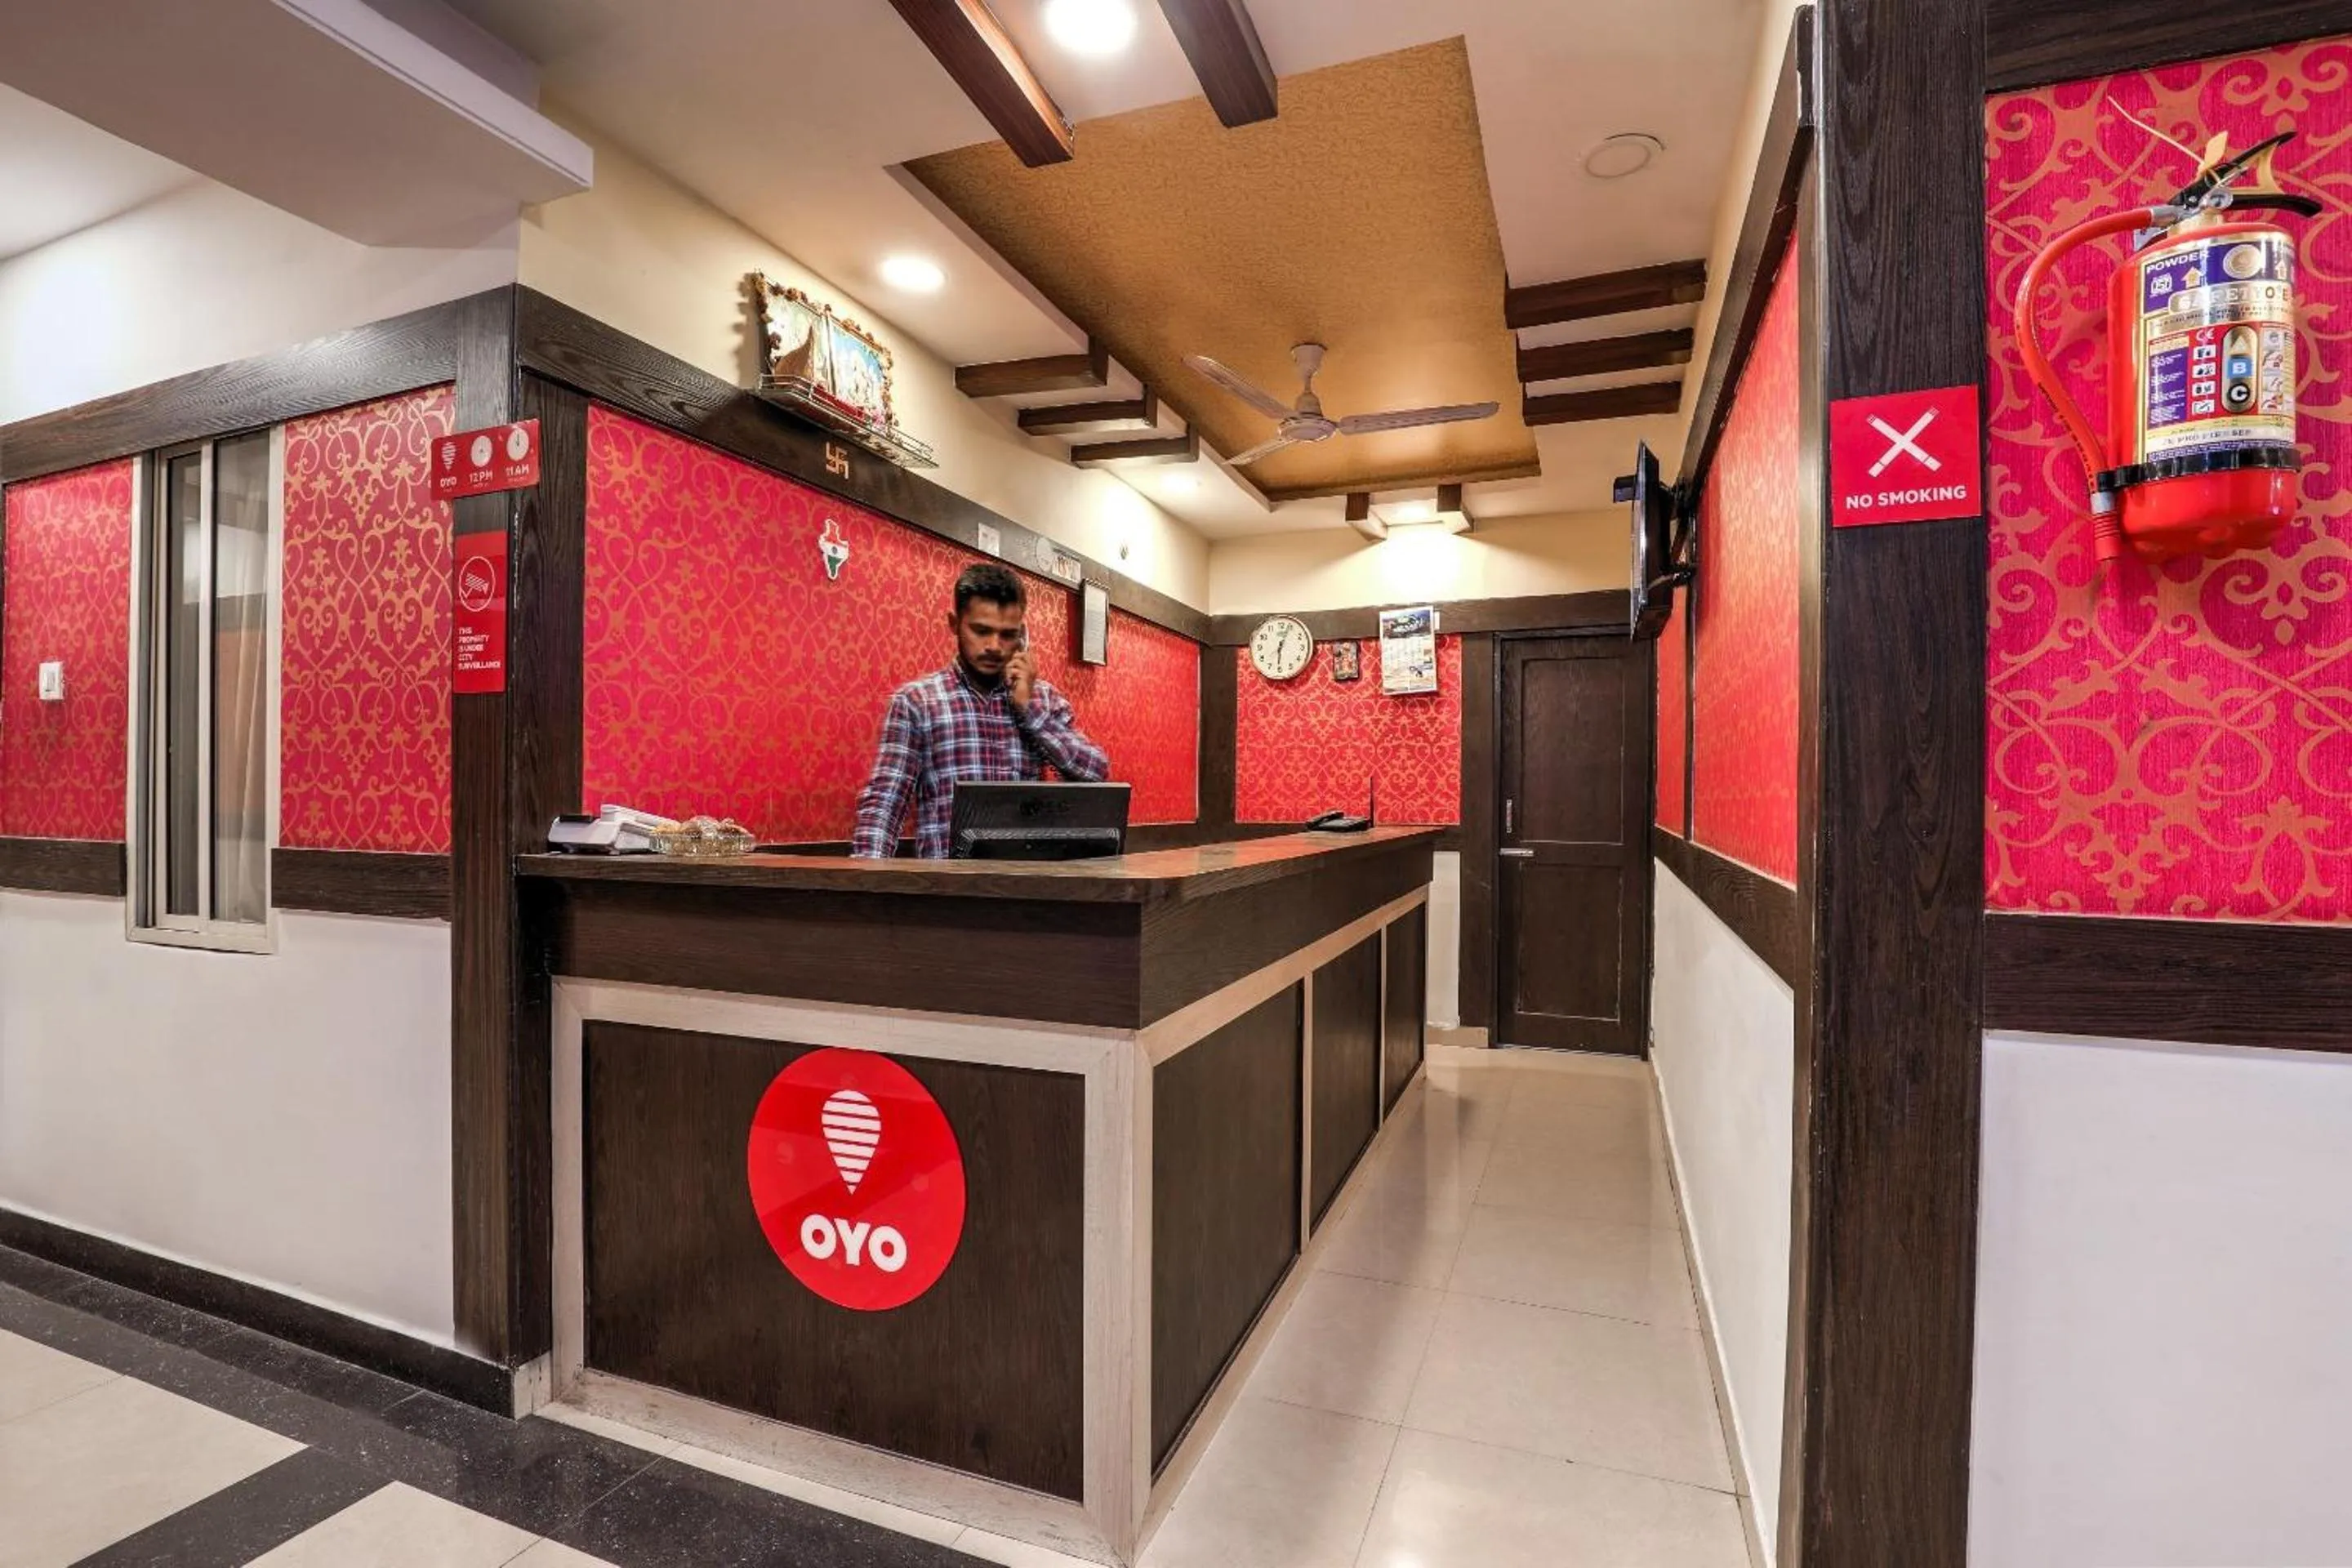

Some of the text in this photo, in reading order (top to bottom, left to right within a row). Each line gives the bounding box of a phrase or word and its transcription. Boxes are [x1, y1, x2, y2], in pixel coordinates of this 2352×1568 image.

[2145, 251, 2210, 274] POWDER
[2231, 362, 2247, 373] B
[2230, 385, 2248, 400] C
[440, 476, 457, 488] OYO
[1846, 485, 1967, 510] NO SMOKING
[800, 1214, 907, 1272] OYO
